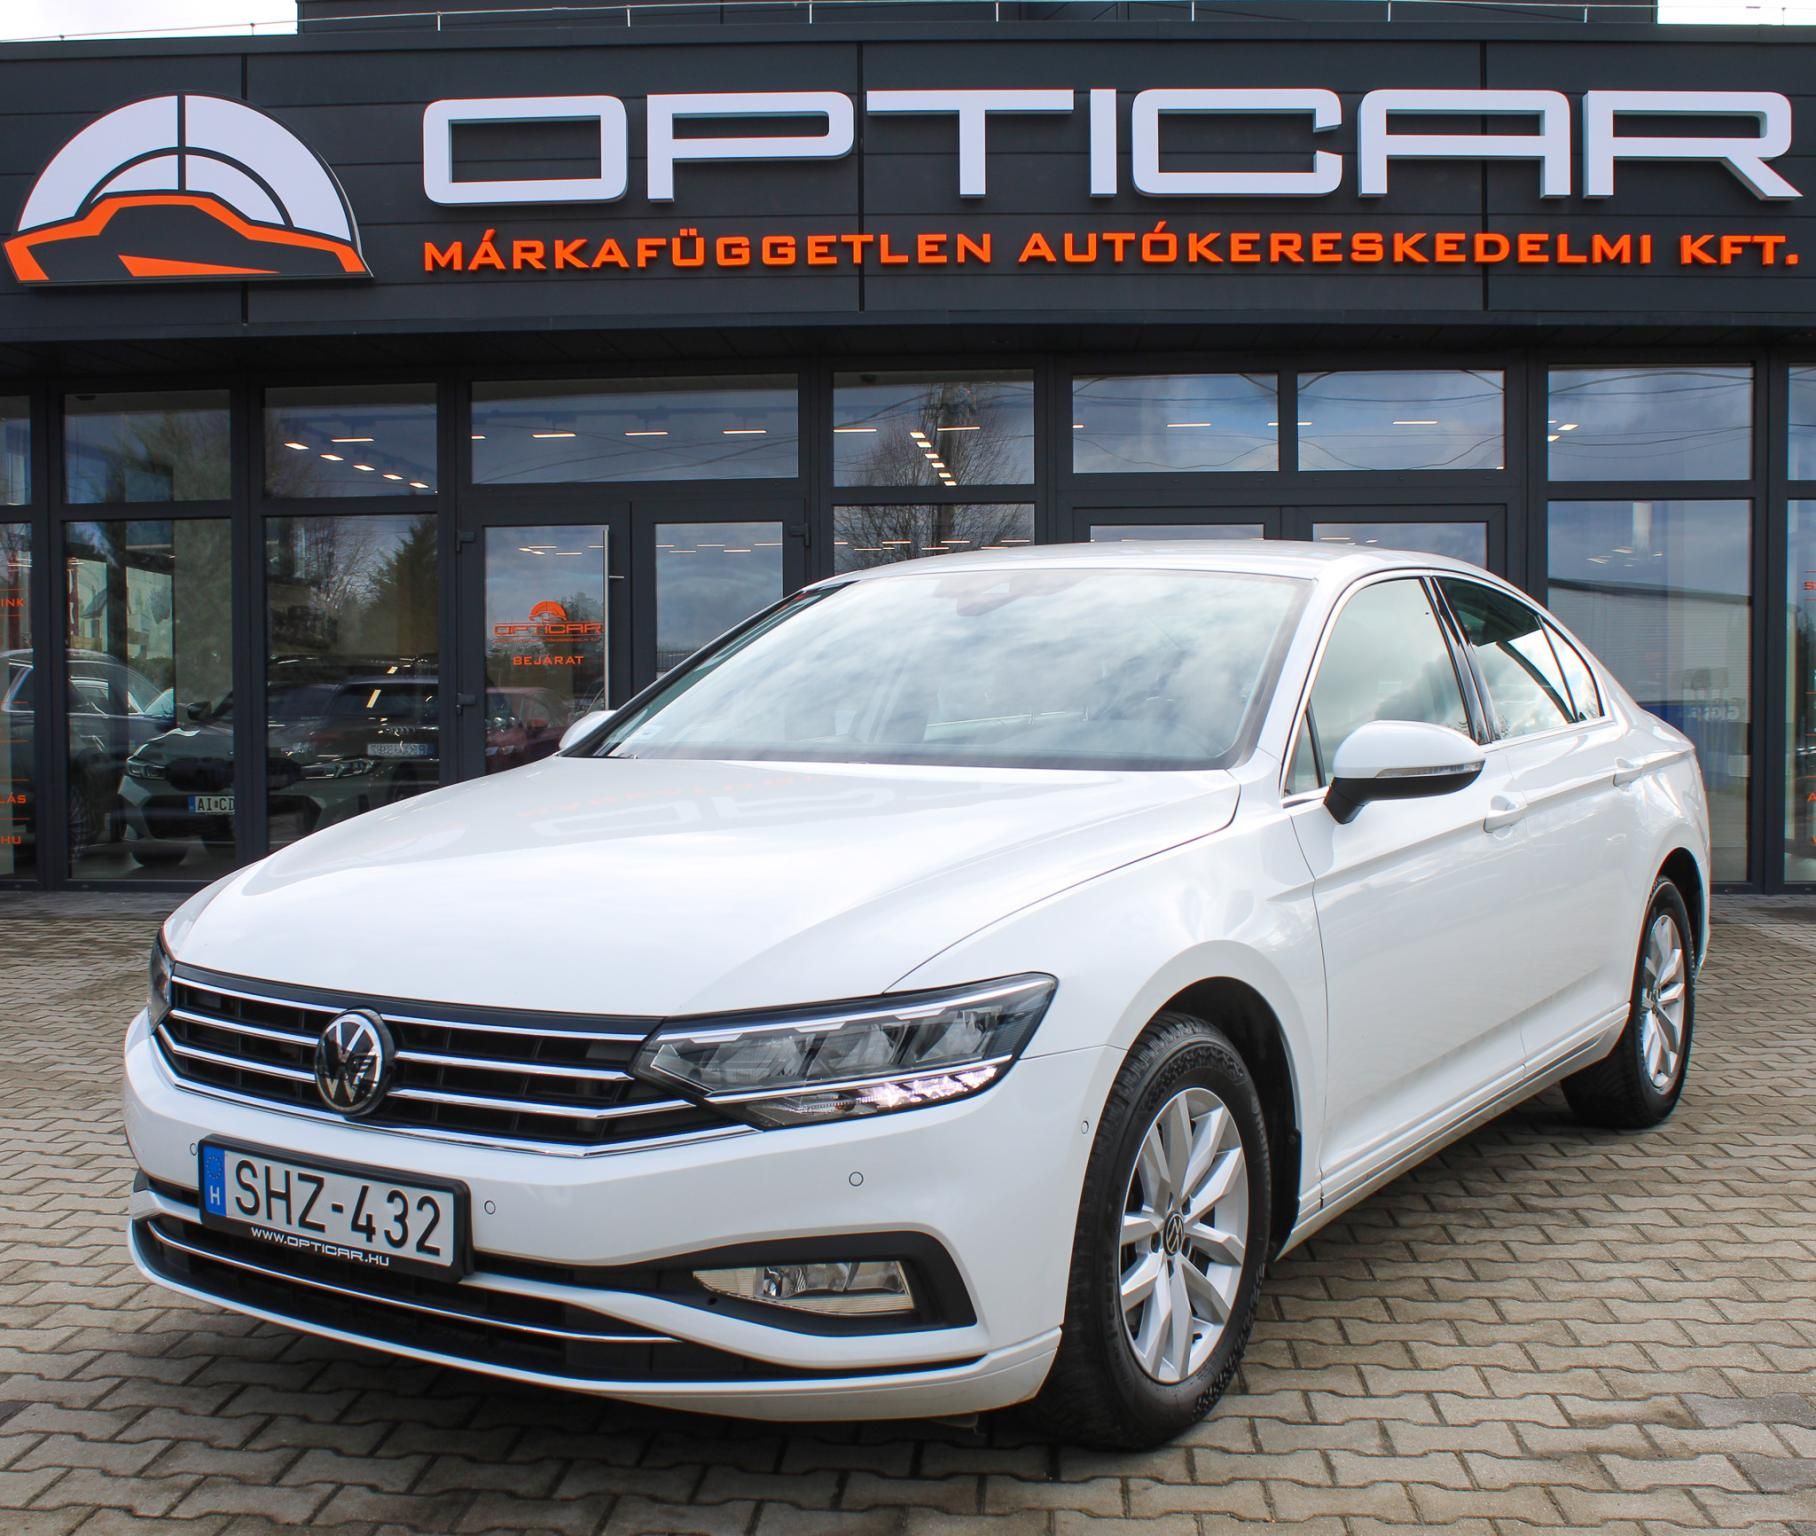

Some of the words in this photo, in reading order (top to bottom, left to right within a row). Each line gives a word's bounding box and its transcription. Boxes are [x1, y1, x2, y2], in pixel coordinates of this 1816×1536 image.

[422, 88, 1803, 206] OPTICAR
[423, 228, 992, 273] MÁRKAFÜGGETLEN
[1017, 220, 1653, 264] AUTÓKERESKEDELMI
[1680, 233, 1801, 266] KFT.
[234, 1159, 441, 1257] SHZ-432
[251, 1226, 390, 1267] WWW.OPTICAR.HU
